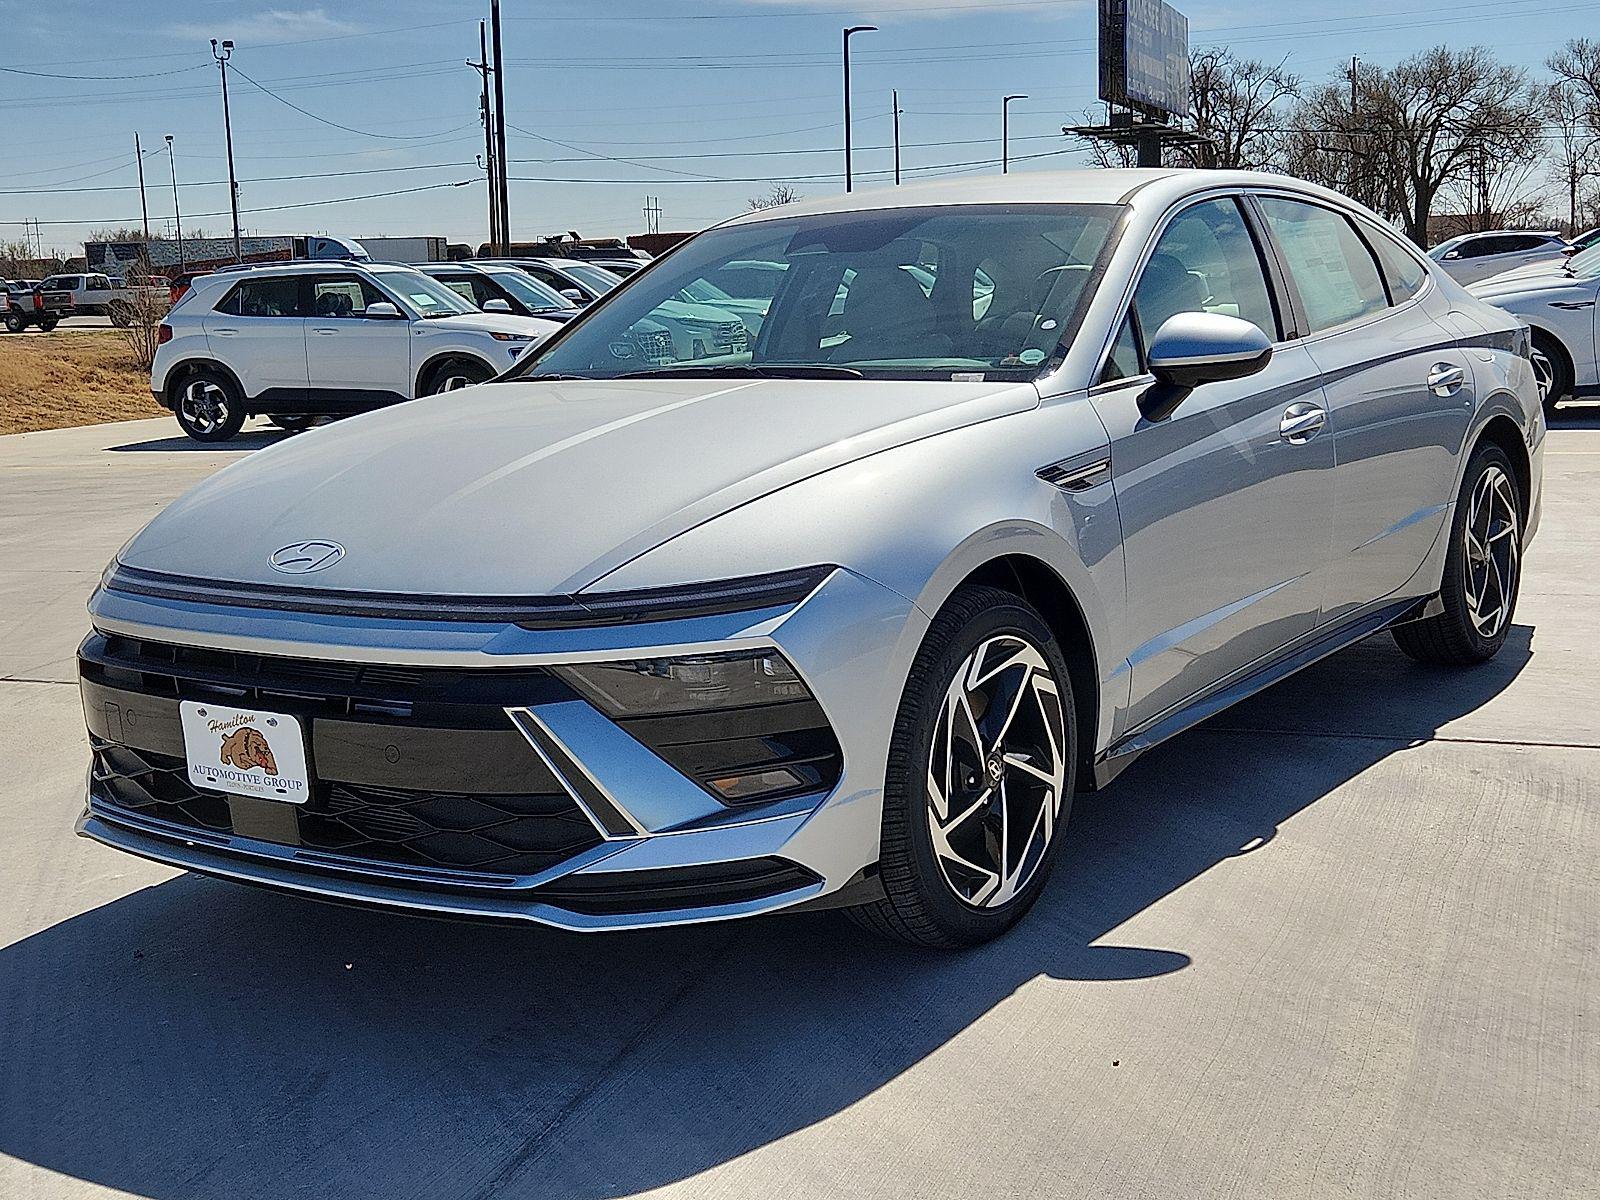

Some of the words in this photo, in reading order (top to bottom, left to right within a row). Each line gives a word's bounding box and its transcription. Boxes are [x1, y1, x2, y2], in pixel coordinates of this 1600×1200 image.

[207, 714, 256, 733] Hamilton
[193, 764, 261, 785] AUTOMOTIVE
[263, 776, 303, 791] GROUP
